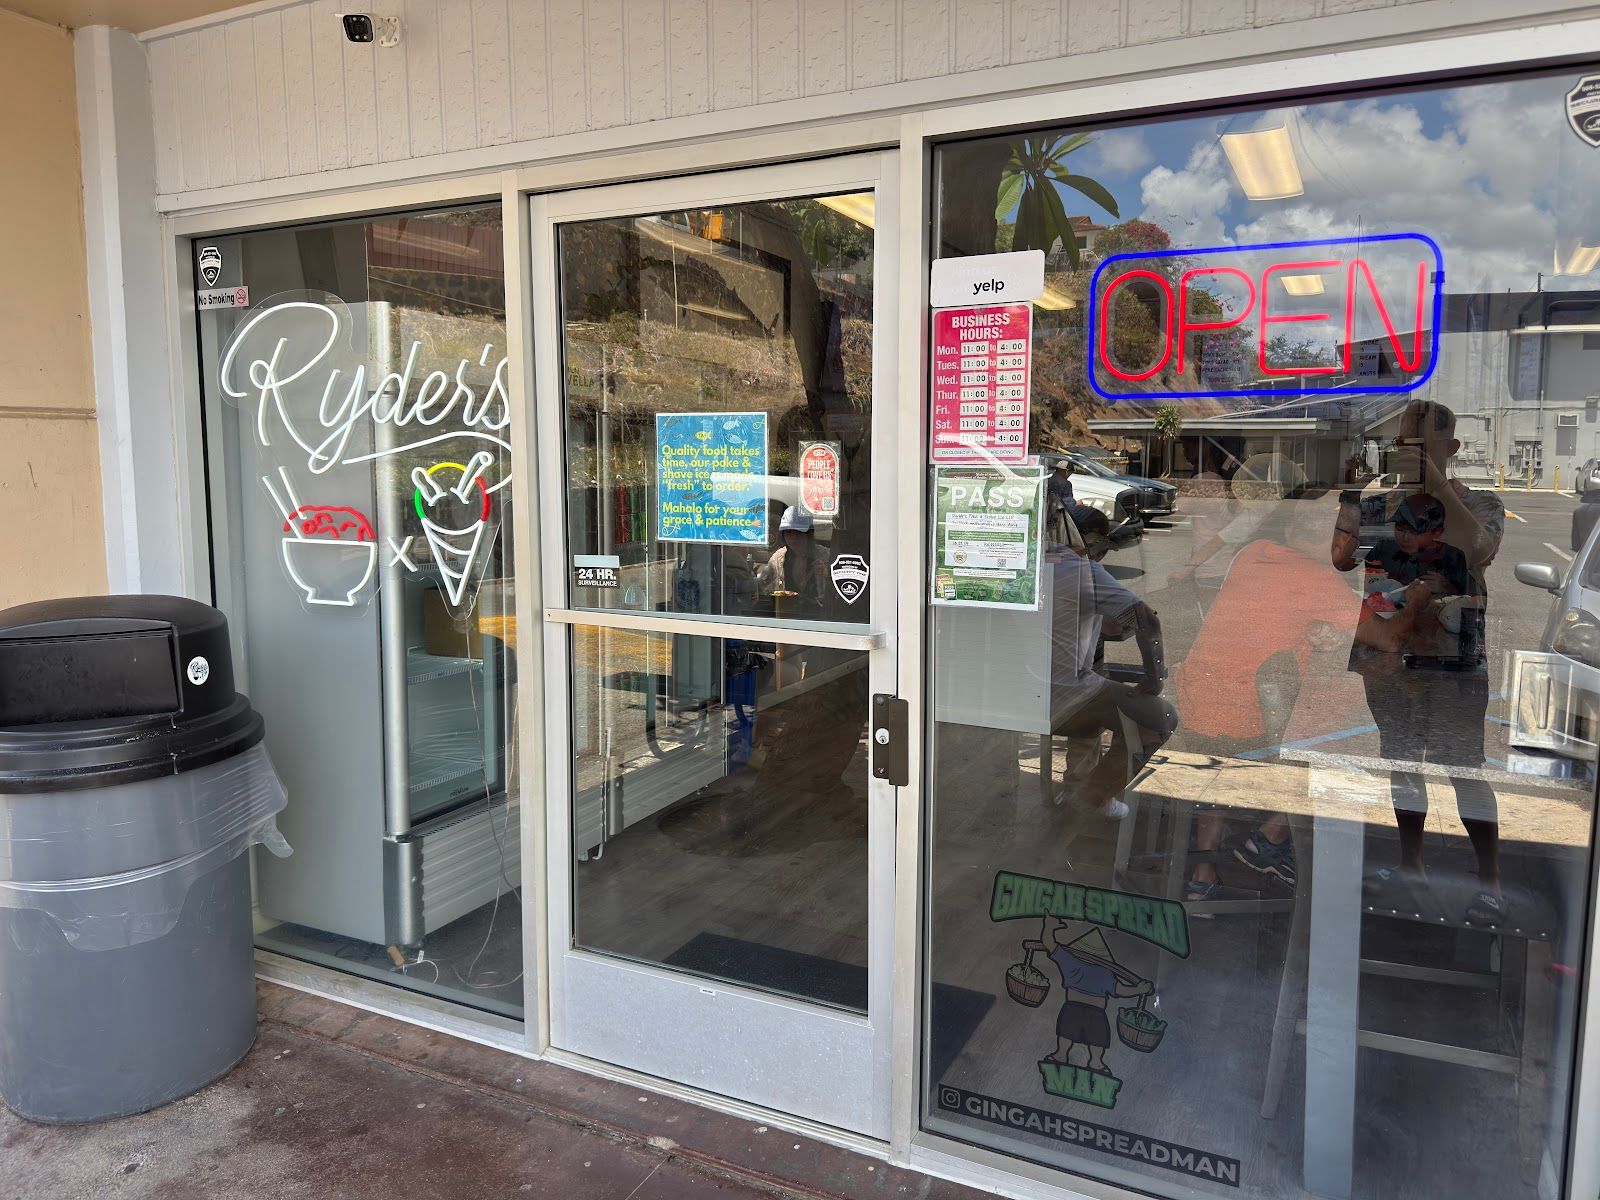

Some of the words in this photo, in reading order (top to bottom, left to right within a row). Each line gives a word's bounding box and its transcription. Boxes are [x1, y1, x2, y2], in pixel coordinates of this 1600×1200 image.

[972, 278, 1005, 295] yelp
[208, 292, 235, 305] Smoking
[951, 312, 1011, 329] BUSINESS
[1099, 258, 1427, 382] OPEN
[959, 327, 1003, 341] HOURS:
[936, 345, 959, 356] Mon.
[989, 344, 997, 352] to
[936, 360, 960, 370] Tues.
[989, 359, 997, 367] to
[936, 375, 959, 385] Wed.
[989, 374, 996, 382] to
[220, 300, 511, 474] Ryder's
[936, 390, 959, 400] Thur.
[935, 405, 950, 415] Fri.
[935, 419, 953, 430] Sat.
[661, 444, 700, 459] Quality
[703, 444, 728, 456] food
[730, 444, 761, 456] takes
[661, 457, 688, 469] time,
[690, 460, 710, 468] our
[741, 456, 751, 468] &
[807, 459, 831, 470] PEOPLE
[662, 468, 693, 479] shave
[695, 468, 710, 479] ice
[702, 482, 714, 491] to
[951, 485, 1024, 508] PASS
[662, 501, 703, 514] Mahalo
[704, 502, 720, 514] for
[722, 506, 749, 518] your
[662, 516, 693, 527] grace
[694, 513, 704, 527] &
[705, 516, 752, 528] patience
[578, 568, 594, 579] 24
[596, 568, 617, 580] HR.
[577, 579, 618, 587] SURVEILLANCE
[1038, 1060, 1123, 1110] MAN
[965, 1096, 1238, 1183] GINGAHSPREADMAN
